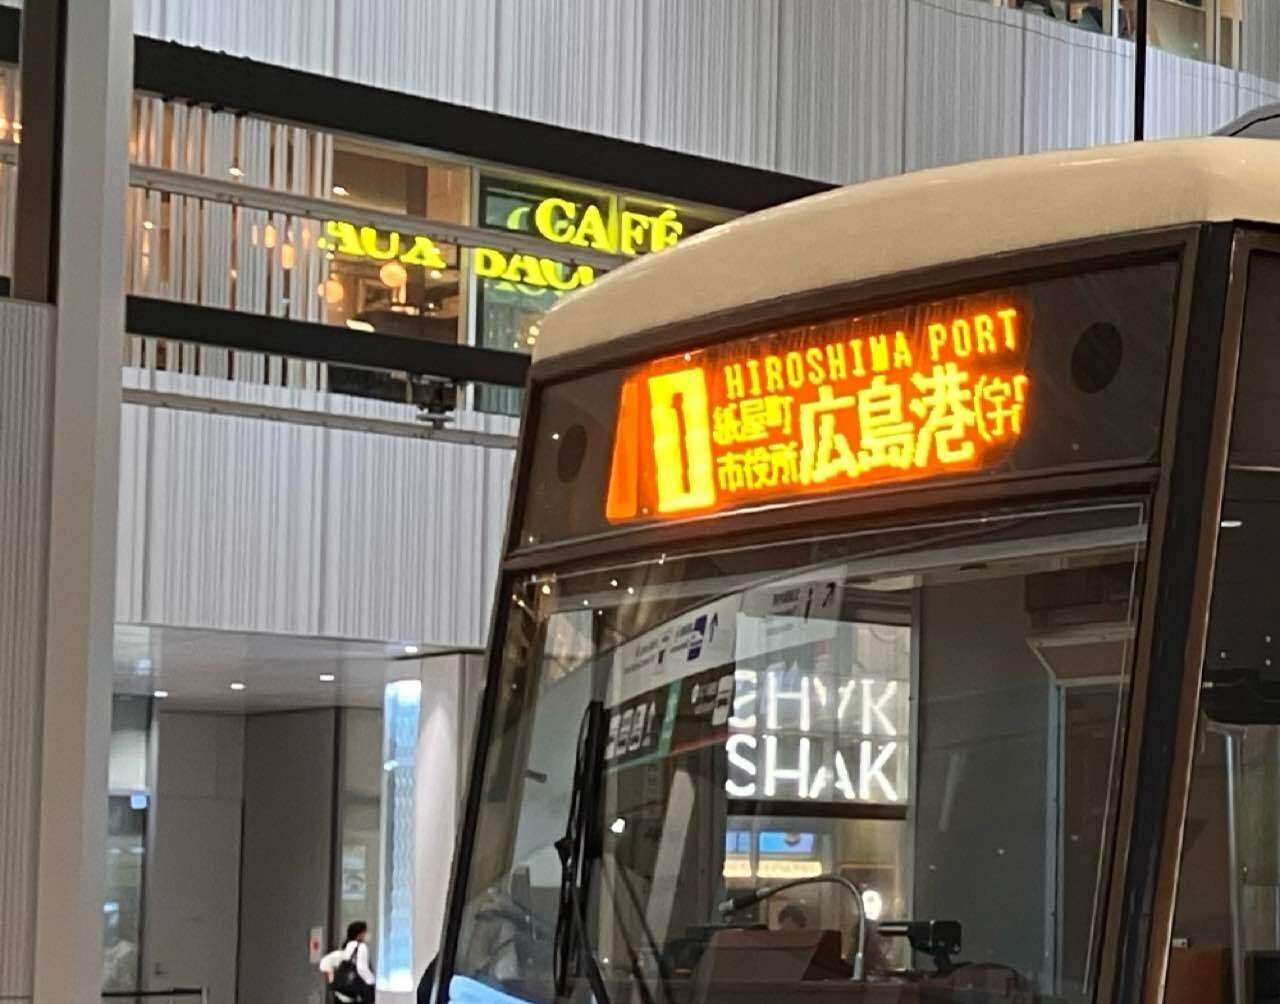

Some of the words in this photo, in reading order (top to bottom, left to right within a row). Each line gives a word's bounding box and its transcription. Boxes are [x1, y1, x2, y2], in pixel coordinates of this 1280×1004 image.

[535, 198, 683, 254] CAFÉ
[726, 331, 912, 395] HIROSHIMA
[928, 310, 1017, 357] PORT
[714, 394, 793, 445] 紙屋町
[717, 440, 801, 493] 市役所
